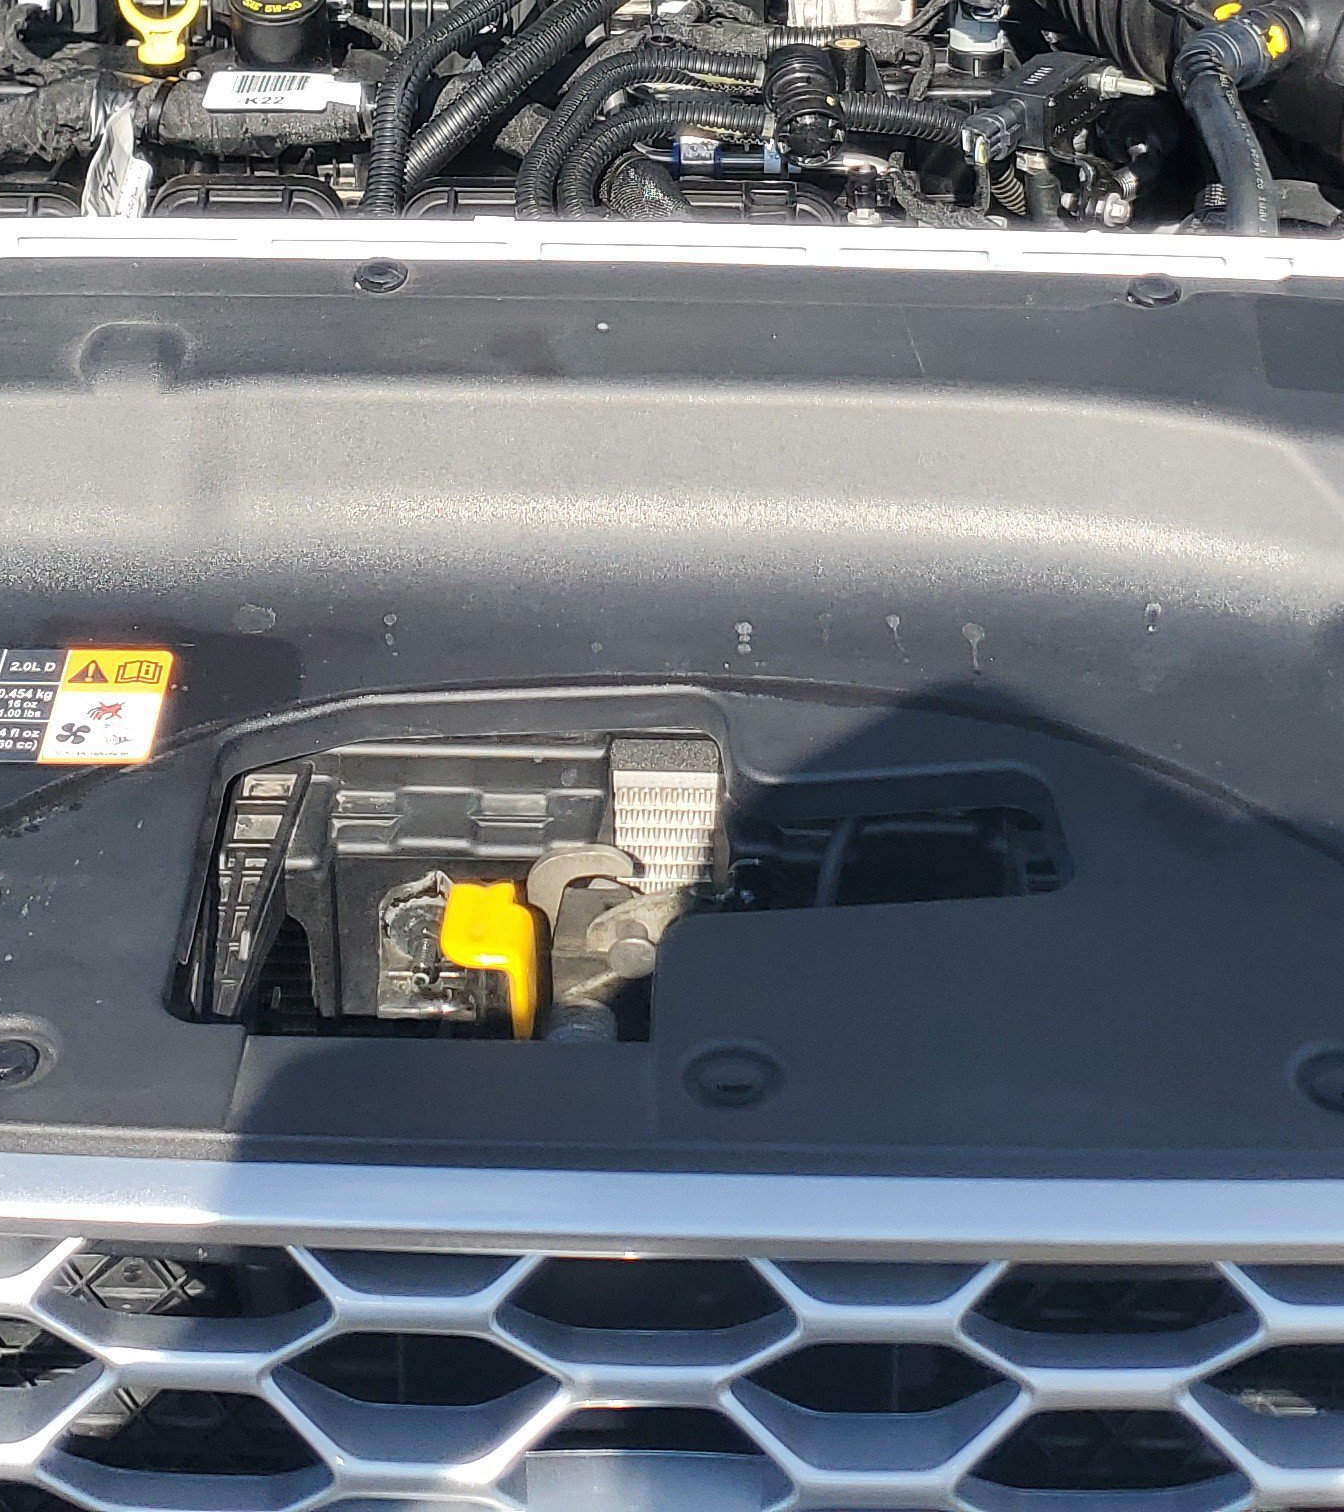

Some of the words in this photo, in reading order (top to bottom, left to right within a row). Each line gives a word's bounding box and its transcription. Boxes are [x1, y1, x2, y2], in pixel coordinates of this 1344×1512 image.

[9, 661, 41, 673] 2.0L
[43, 661, 57, 673] D
[36, 690, 54, 701] kg
[23, 701, 38, 709] oz
[23, 709, 42, 718] lbs
[10, 727, 20, 738] fl
[22, 730, 41, 738] oz
[16, 740, 38, 751] cc)
